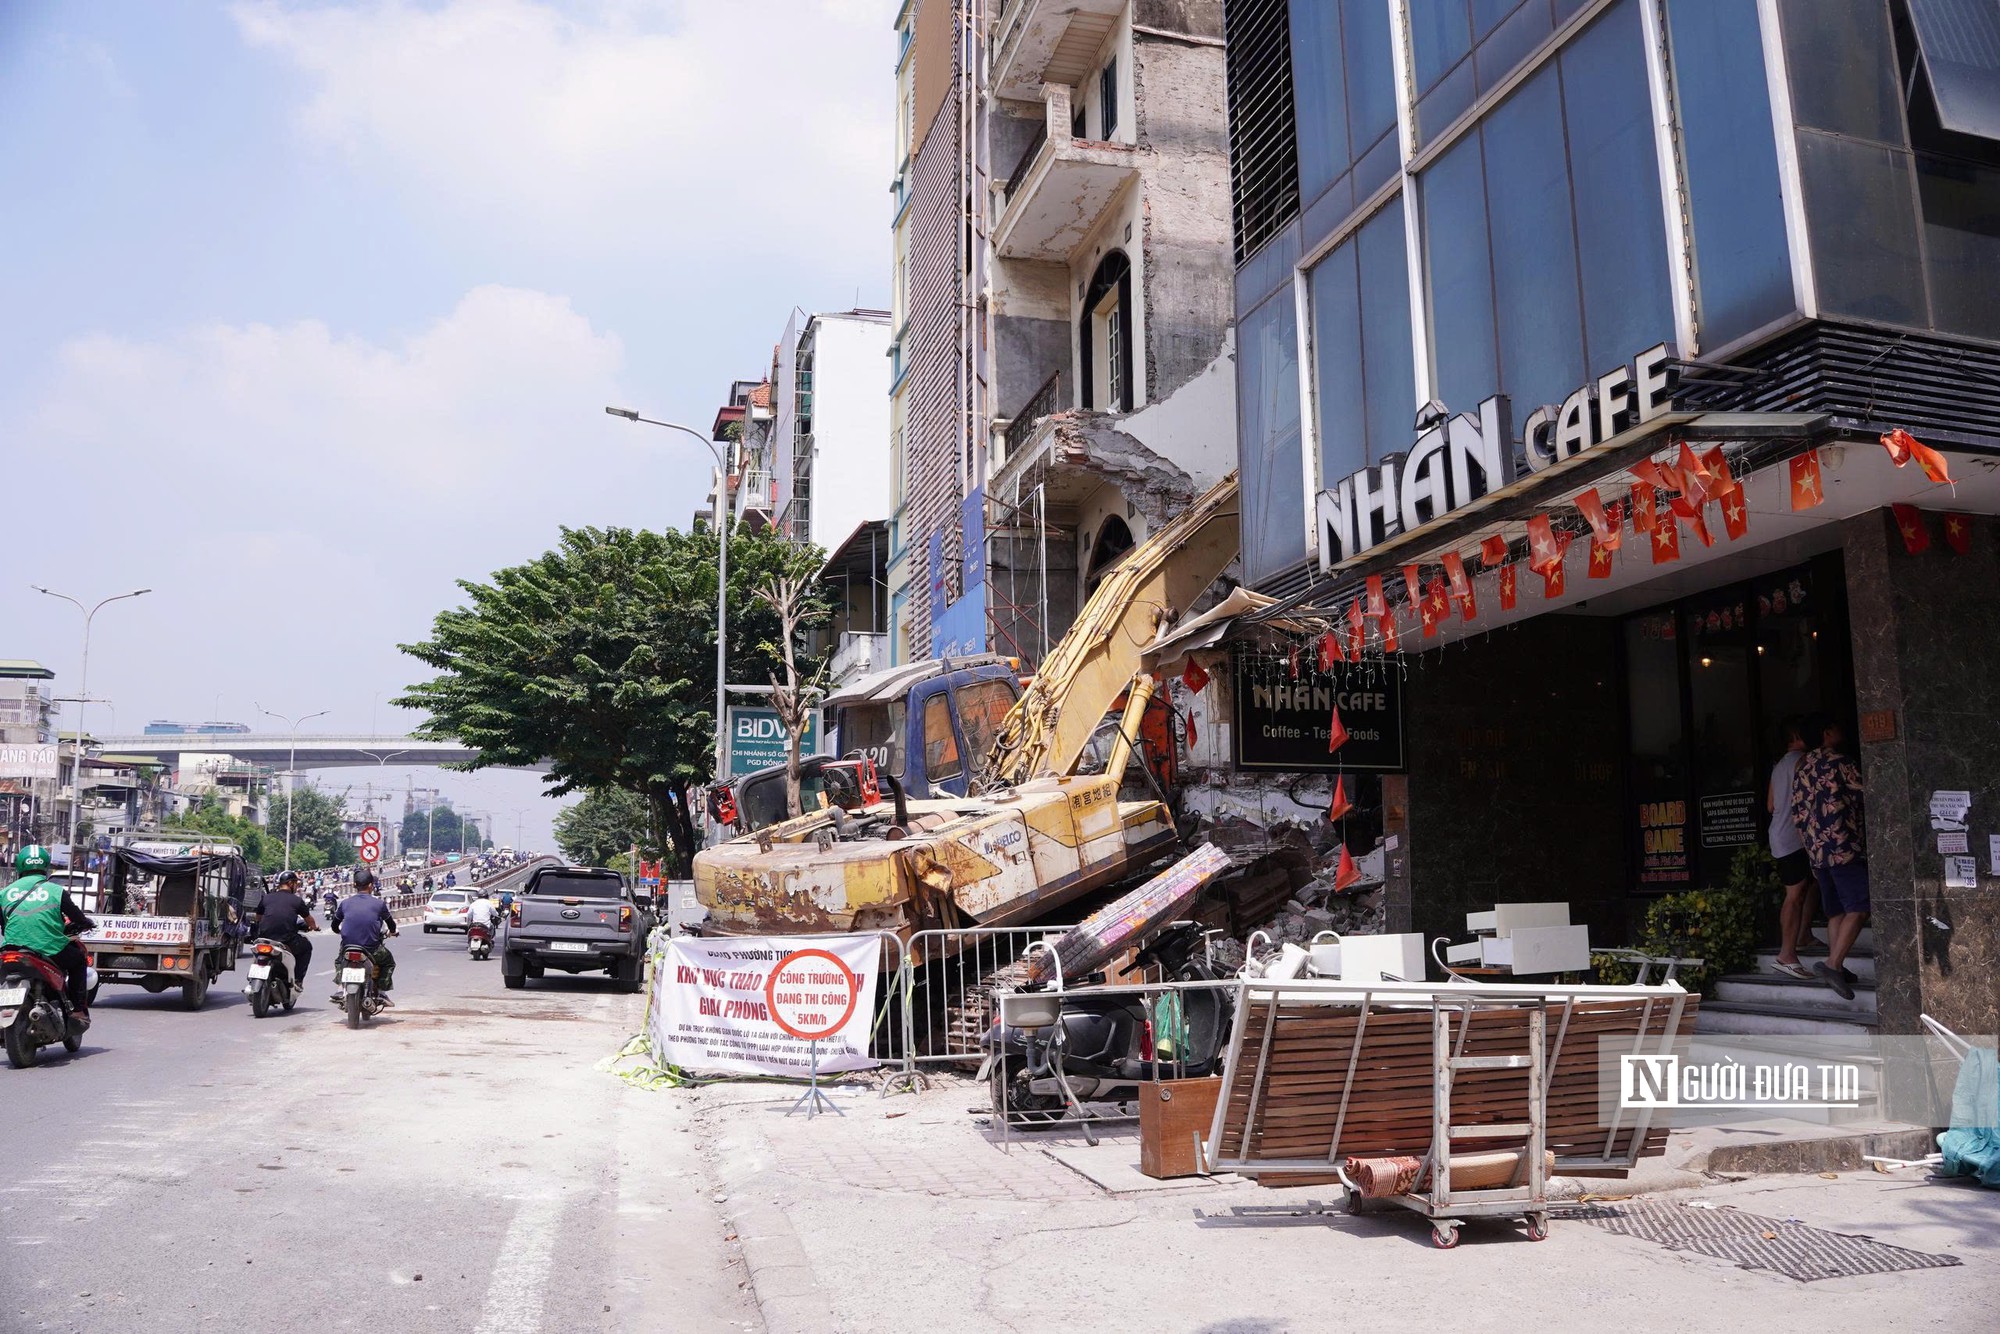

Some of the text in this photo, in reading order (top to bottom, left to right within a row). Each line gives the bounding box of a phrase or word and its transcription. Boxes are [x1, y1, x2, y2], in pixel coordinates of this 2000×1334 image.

[1315, 341, 1680, 574] NHÂN CAFE
[1252, 679, 1386, 712] NHÂN CAFE
[737, 717, 787, 739] BIDV
[1262, 724, 1300, 738] Coffee
[1347, 727, 1380, 741] Foods
[1639, 800, 1687, 828] BOARD
[1644, 827, 1685, 854] GAME
[25, 857, 44, 865] Grab
[102, 919, 112, 928] XE
[120, 931, 144, 940] 0392
[146, 932, 164, 940] 542
[167, 933, 184, 941] 178
[732, 948, 773, 961] PHƯỜNG
[729, 970, 763, 991] THÁO
[780, 970, 805, 985] CÔNG
[808, 969, 844, 985] TRƯỜNG
[776, 991, 847, 1006] ĐANG THI CÔNG
[724, 998, 768, 1021] PHÓNG
[797, 1013, 827, 1025] 5KM/h
[668, 1034, 679, 1042] THEO
